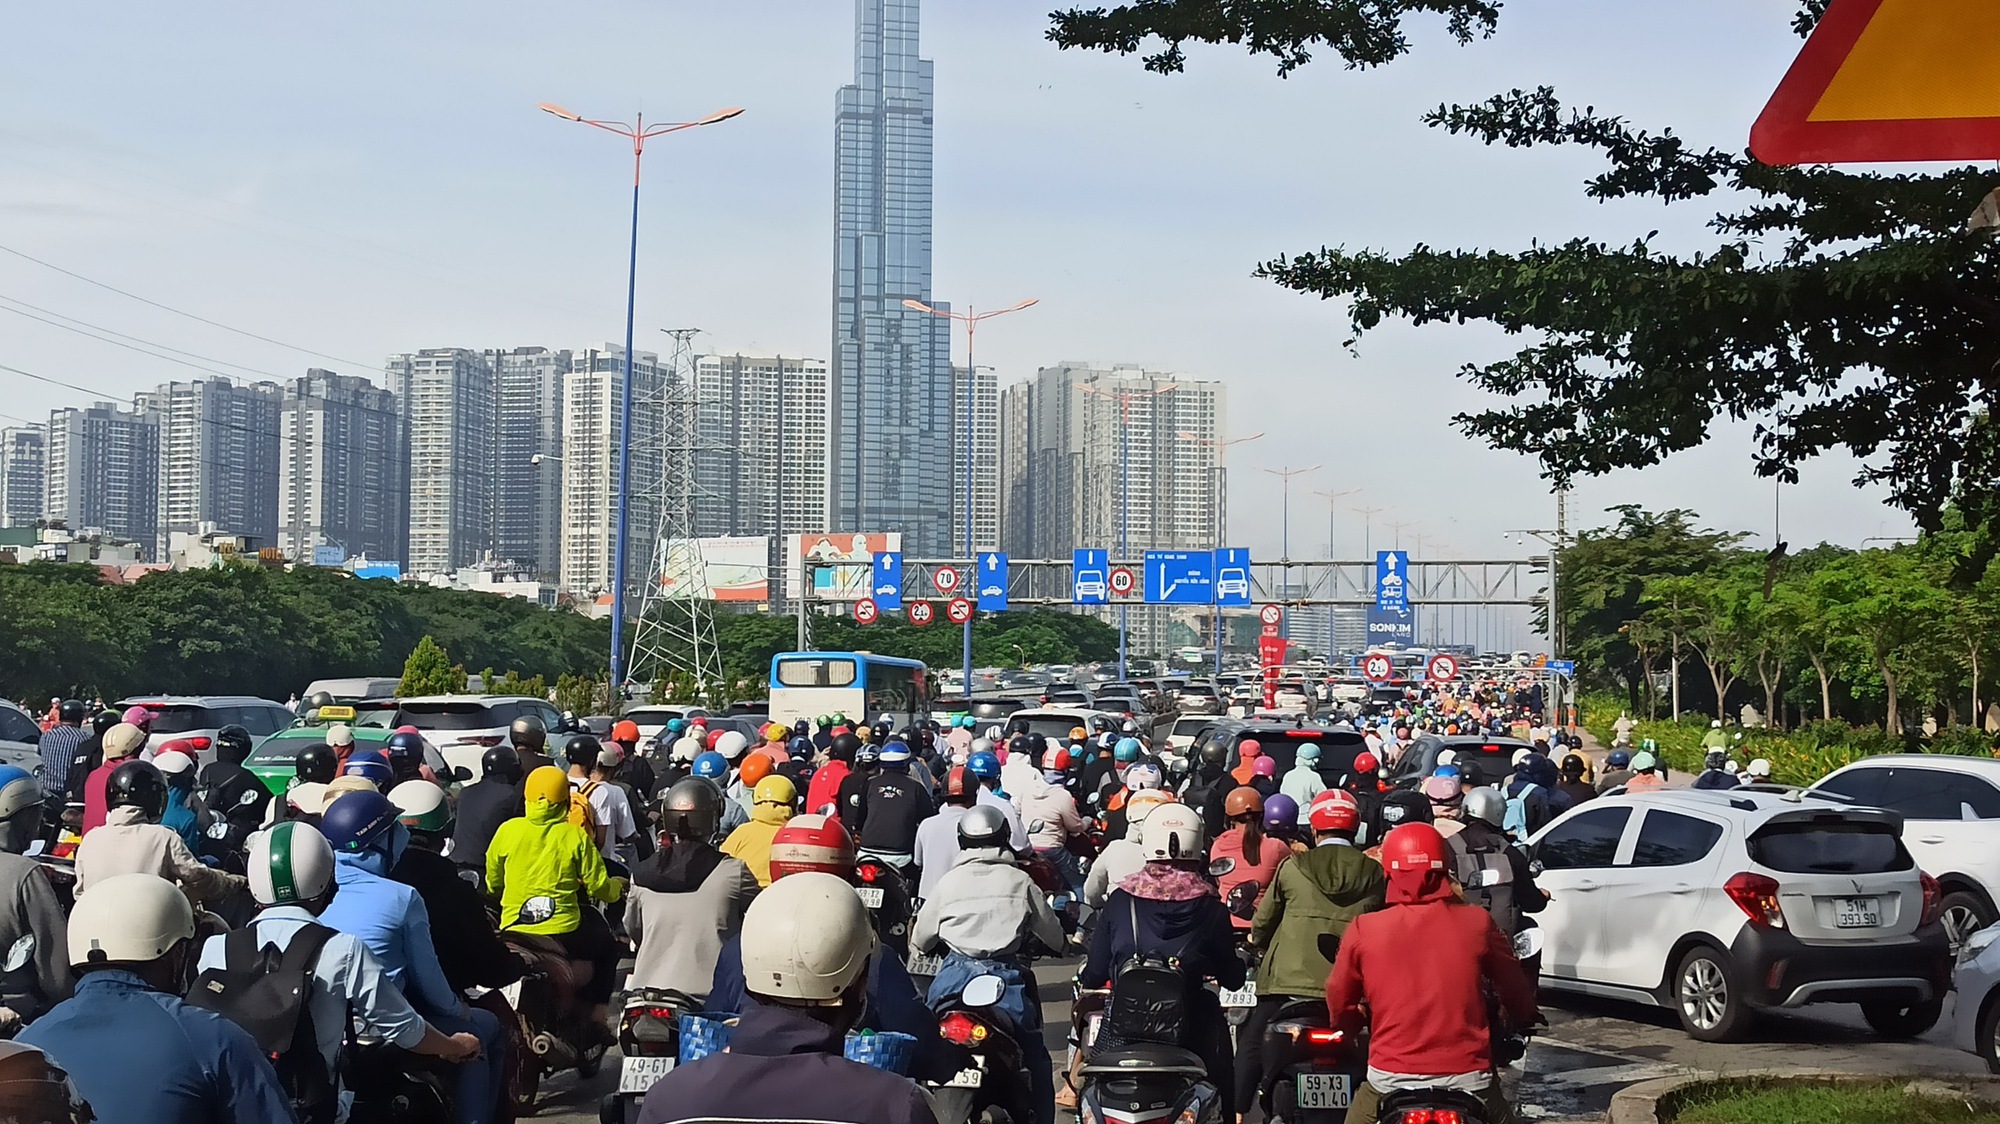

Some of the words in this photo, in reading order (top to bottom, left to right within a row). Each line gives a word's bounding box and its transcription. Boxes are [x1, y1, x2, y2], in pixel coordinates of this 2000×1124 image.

[940, 573, 951, 584] 70
[1116, 575, 1127, 586] 60
[1846, 900, 1867, 912] 51H
[909, 963, 938, 974] 2079
[1225, 993, 1252, 1004] 7893
[629, 1058, 667, 1073] 49-G1
[1306, 1076, 1343, 1090] 59-X3
[1302, 1092, 1348, 1107] 491.40
